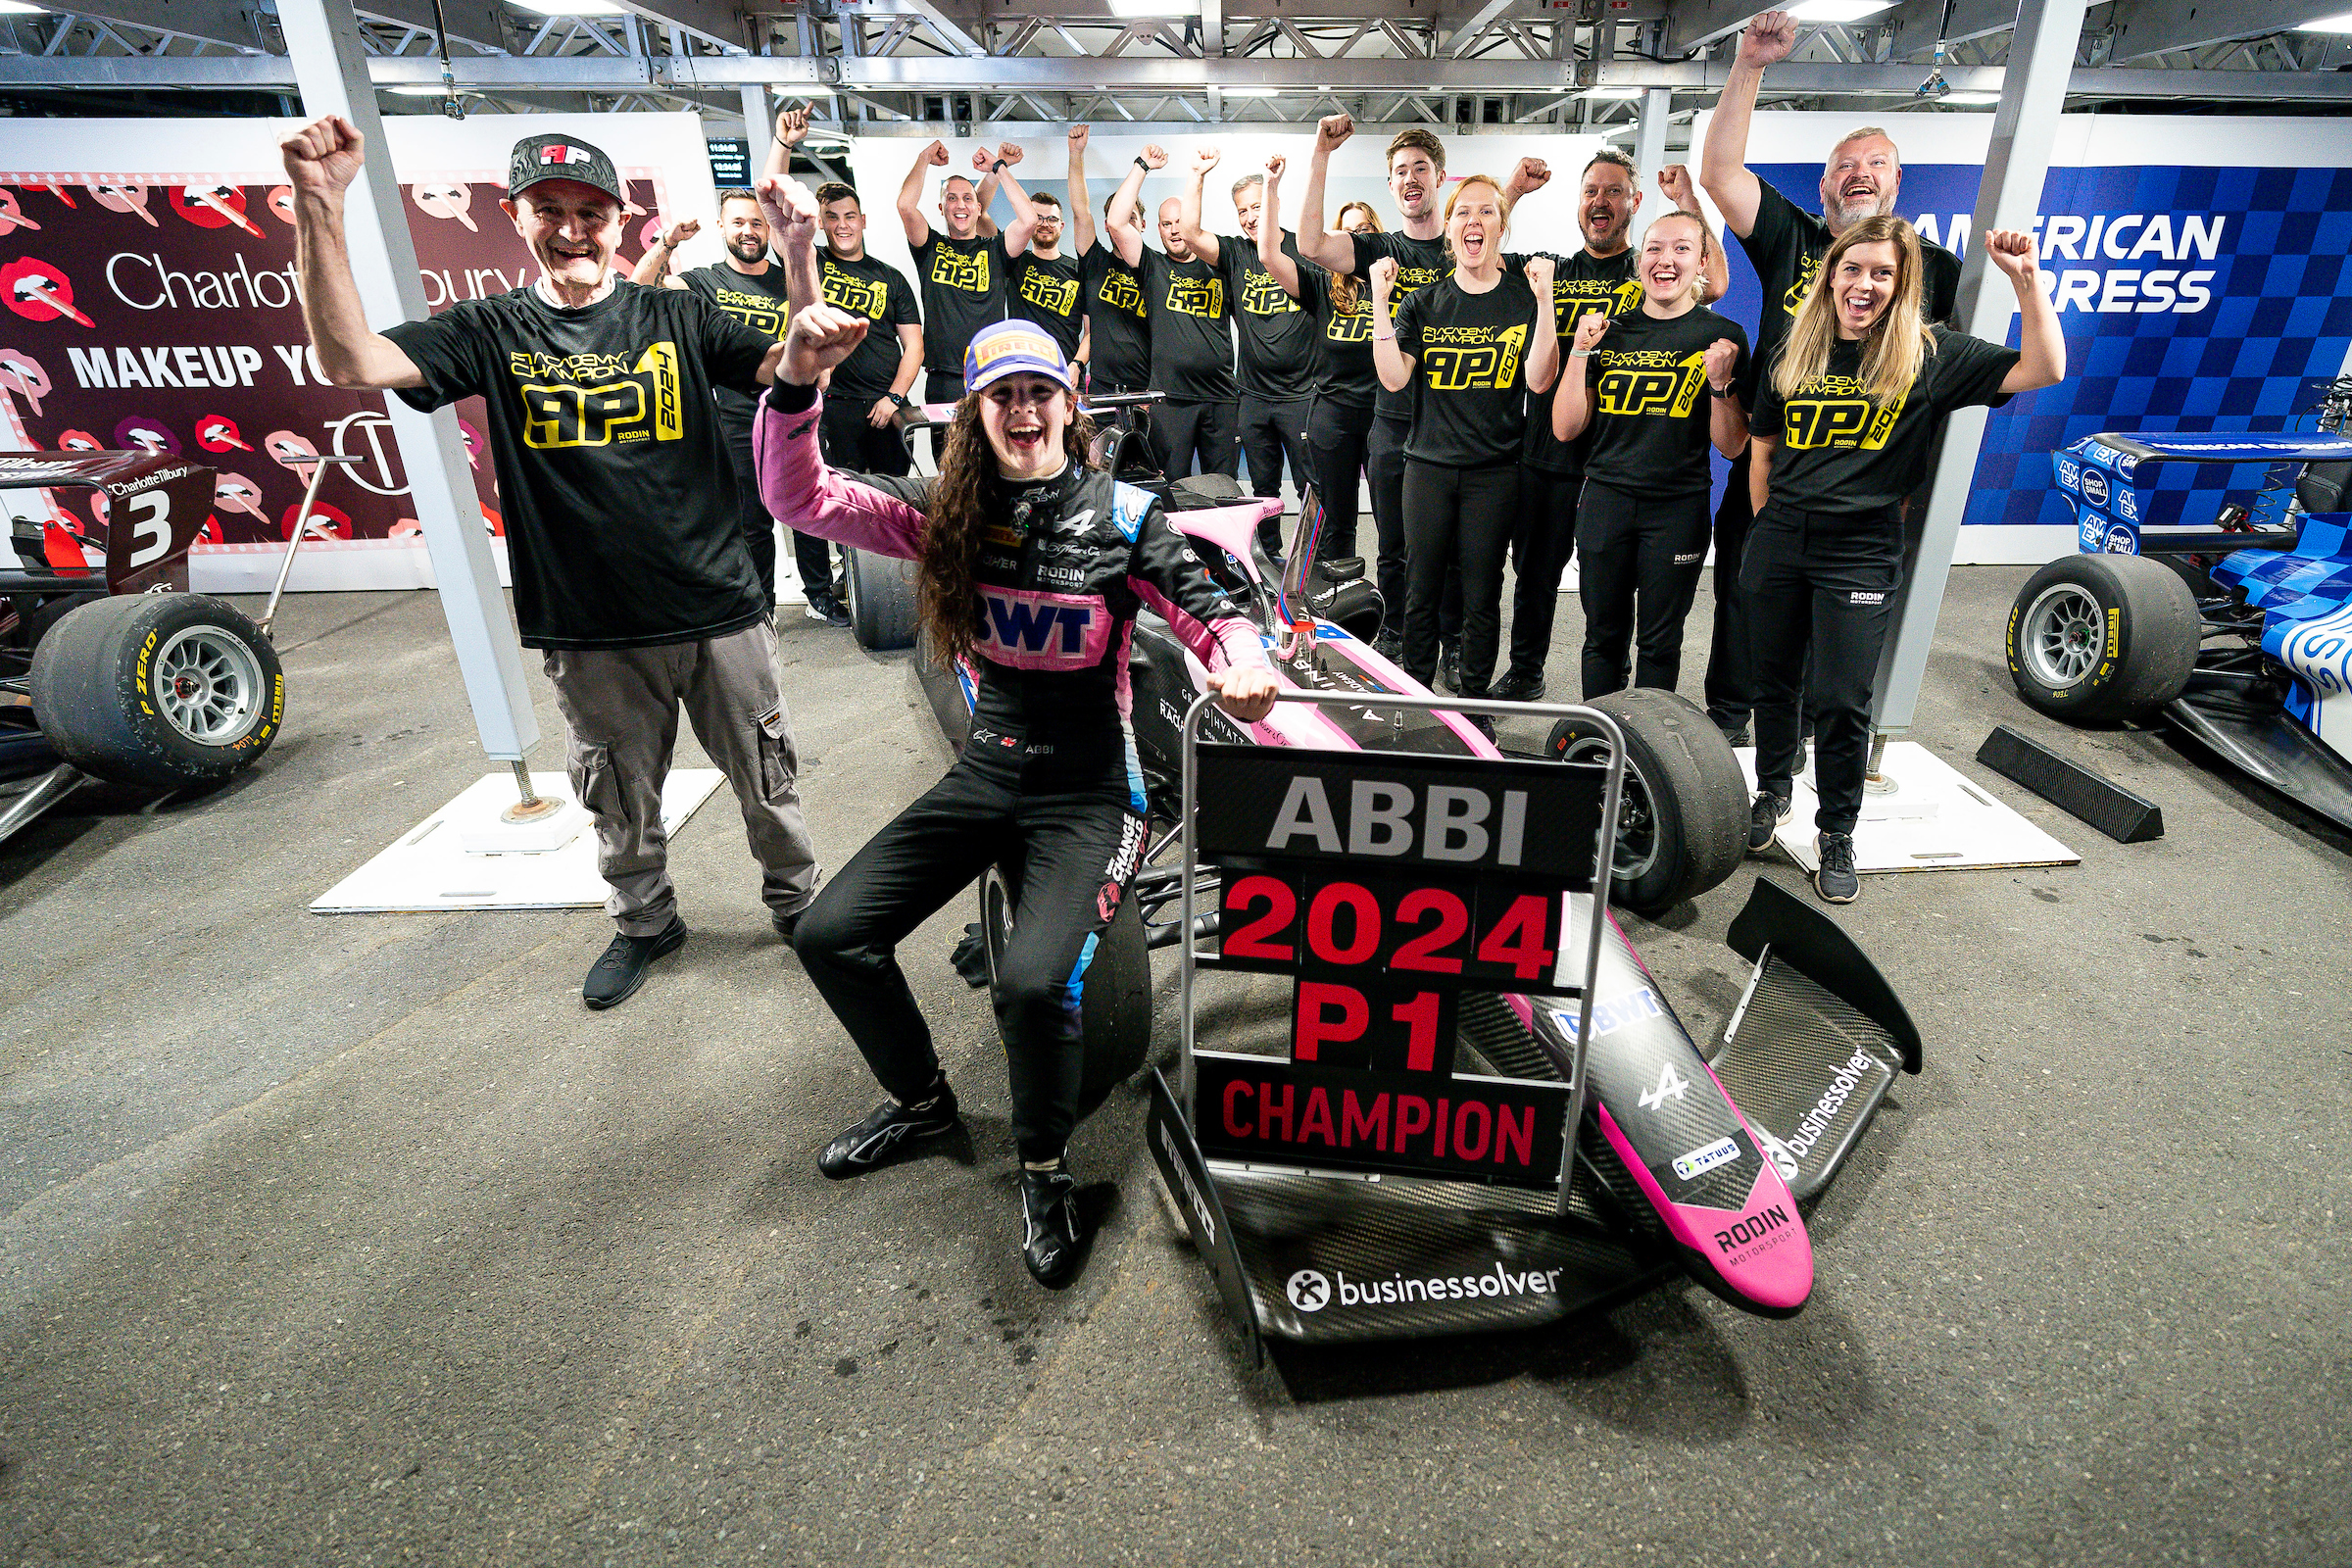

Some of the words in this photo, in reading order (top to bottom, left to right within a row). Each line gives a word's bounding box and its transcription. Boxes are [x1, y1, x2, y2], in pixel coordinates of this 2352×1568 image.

[540, 144, 591, 166] AP
[1913, 213, 2226, 260] ARICAN
[106, 253, 303, 310] Charlot
[1398, 267, 1437, 275] CADEMY
[1398, 275, 1439, 284] AMPION
[1422, 333, 1494, 344] CHAMPION
[1436, 326, 1494, 336] ACADEMY
[534, 350, 624, 368] ACADEMY
[981, 335, 1054, 361] PIRELLI
[1499, 331, 1522, 383] 2024
[1600, 357, 1677, 368] CHAMPION
[1615, 350, 1678, 361] ACADEMY
[67, 346, 263, 388] MAKEUP
[272, 345, 333, 386] YO
[511, 362, 629, 382] CHAMPION
[656, 350, 677, 432] 2024
[617, 429, 651, 440] RODIN
[2084, 477, 2104, 489] SHOP
[2085, 485, 2108, 498] SMALL
[129, 489, 172, 568] 3
[2109, 533, 2131, 545] SHOP
[1037, 564, 1085, 582] RODIN
[1674, 553, 1700, 562] RODIN
[1850, 591, 1885, 601] RODIN
[2006, 606, 2019, 659] ZERO
[2107, 608, 2120, 658] PIRELLI
[136, 629, 159, 697] ZERO
[1026, 744, 1054, 755] ABBI
[1265, 776, 1528, 866] ABBI
[1111, 812, 1136, 882] CHANGE
[1125, 819, 1144, 876] WORLD
[1223, 875, 1555, 980] 2024
[1592, 990, 1658, 1032] BWT
[1787, 1046, 1873, 1157] businessolver
[1222, 1079, 1536, 1166] CHAMPION
[1694, 1144, 1737, 1166] TATUUS
[1714, 1204, 1789, 1253] RODIN
[1729, 1228, 1798, 1267] MOTORSPORT
[1338, 1261, 1562, 1307] businessolver
